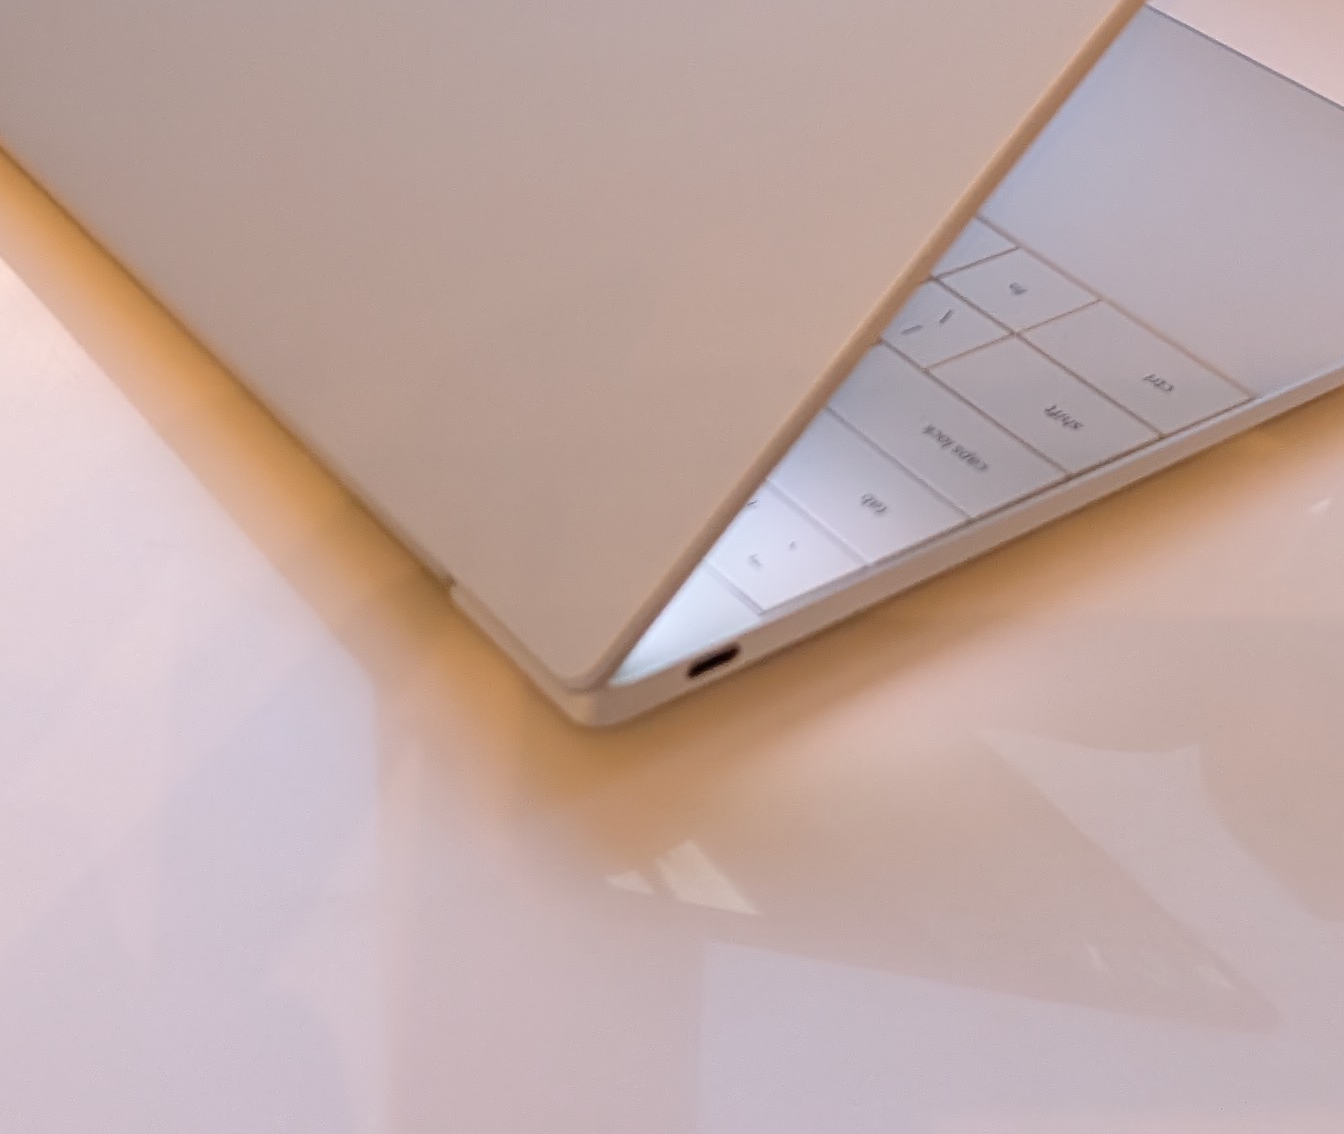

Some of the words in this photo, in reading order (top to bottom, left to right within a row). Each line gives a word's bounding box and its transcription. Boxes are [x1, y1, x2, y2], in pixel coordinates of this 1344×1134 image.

[1142, 373, 1175, 392] ctrl
[1044, 404, 1084, 430] shift
[923, 422, 956, 449] lock
[952, 444, 988, 471] caps
[860, 494, 888, 514] tab
